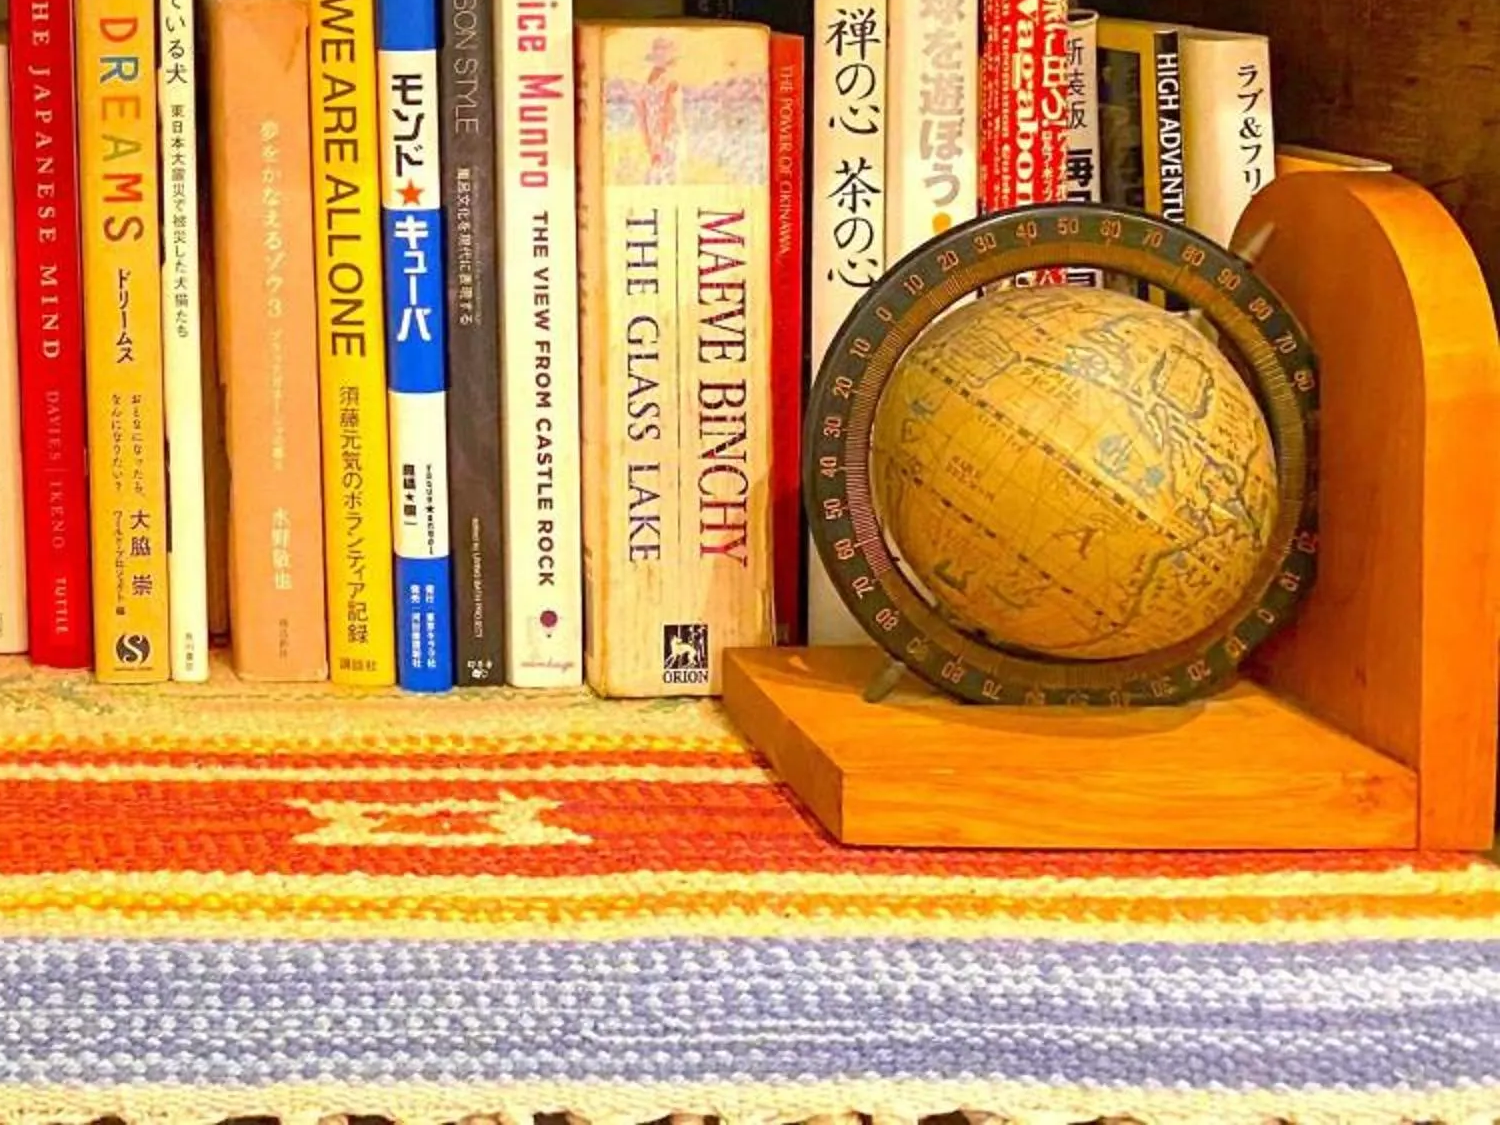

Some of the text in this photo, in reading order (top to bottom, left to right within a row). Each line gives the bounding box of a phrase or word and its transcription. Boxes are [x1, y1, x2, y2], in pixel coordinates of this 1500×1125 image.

[321, 73, 360, 165] ARE
[454, 58, 481, 134] STYLE
[825, 7, 883, 137] 禅の心
[1156, 52, 1180, 111] HIGH
[28, 64, 59, 244] JAPANESE
[99, 16, 145, 245] DREAMS
[518, 73, 565, 189] Munro
[778, 64, 794, 255] THE POWER OF OKINAWA
[324, 173, 363, 258] ALL
[391, 73, 434, 343] モンド キューバ
[826, 155, 883, 289] 茶の心
[903, 273, 926, 297] 10
[936, 250, 960, 272] 20
[974, 232, 998, 254] 30
[1015, 221, 1038, 242] 40
[1057, 218, 1081, 238] 50
[1141, 228, 1164, 251] 70
[38, 263, 62, 360] MIND
[327, 261, 368, 359] ONE
[531, 209, 556, 587] THE VIEW FROM CASTLE ROCK
[625, 208, 662, 565] THE GLASS LAKE
[696, 208, 750, 568] MAEVE BINCHY
[823, 416, 843, 439] 30
[832, 375, 855, 399] 20
[45, 389, 67, 551] DAVIES IKENO
[337, 385, 370, 645] 須藤元気のボランティア記録
[819, 456, 838, 478] 40
[54, 576, 70, 636] TUTTLE
[662, 669, 710, 685] ORION
